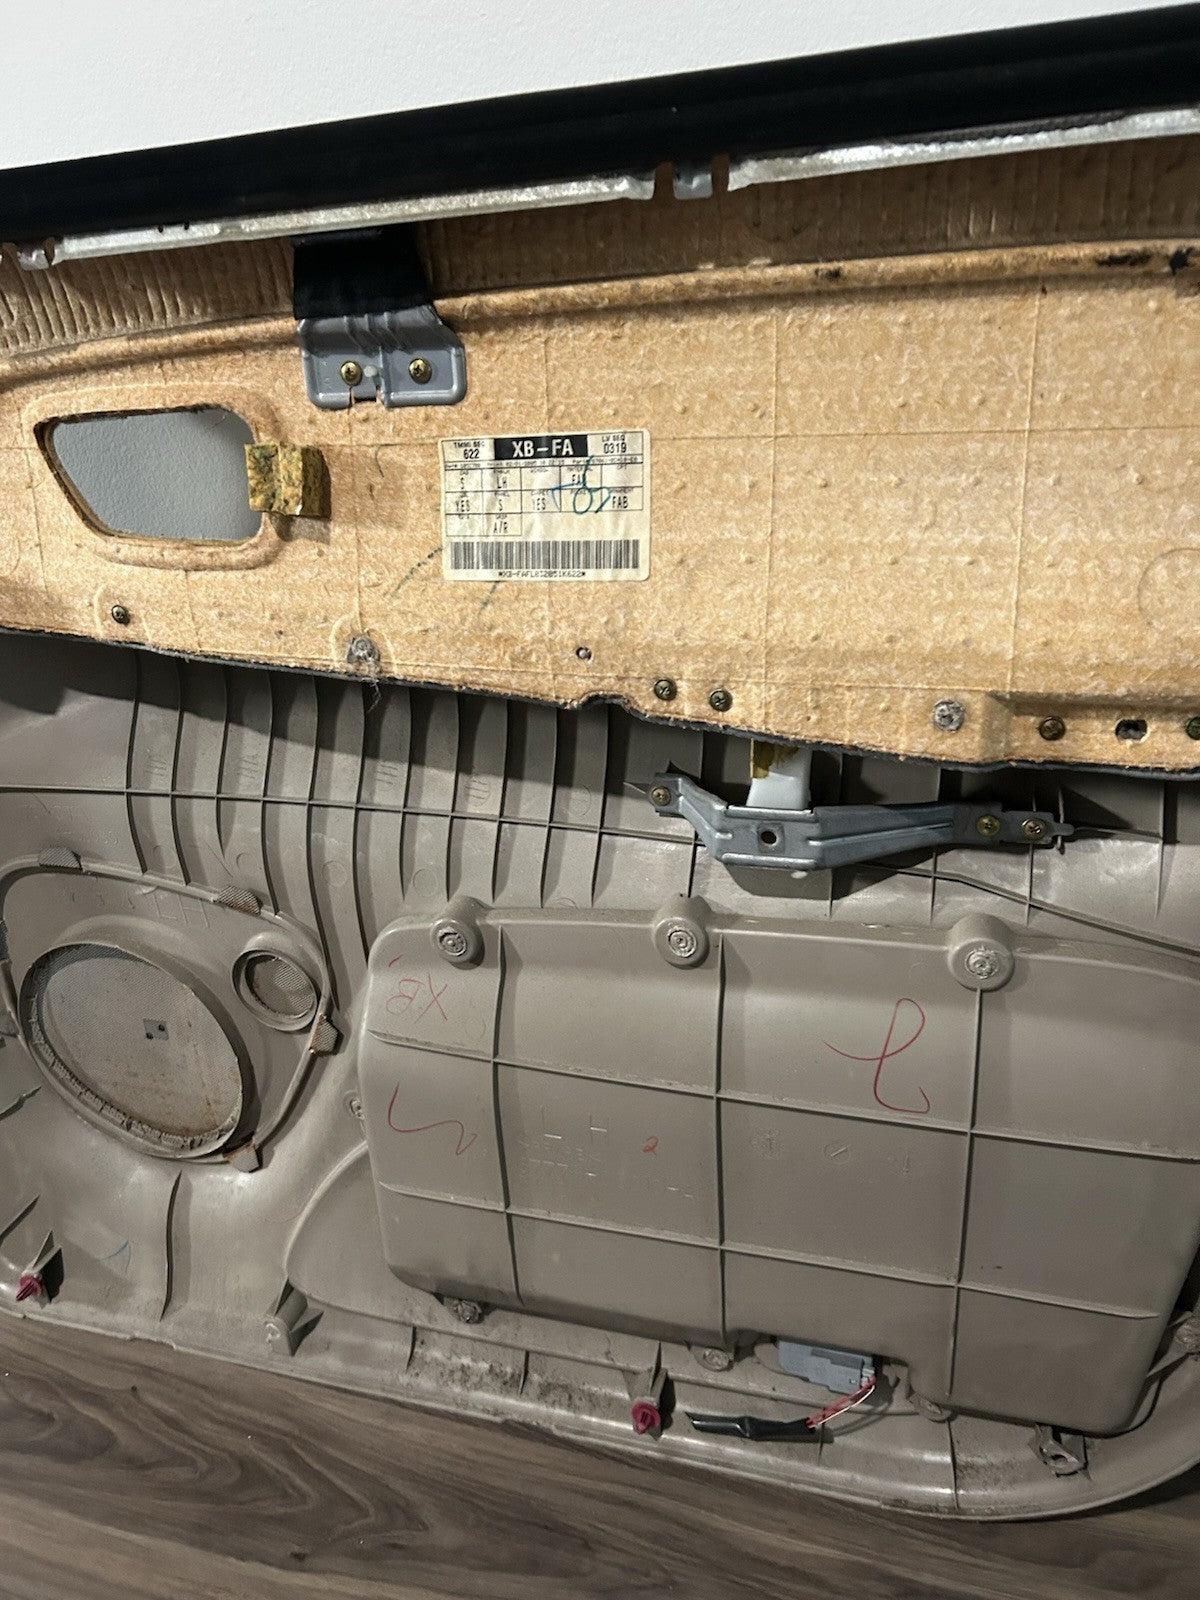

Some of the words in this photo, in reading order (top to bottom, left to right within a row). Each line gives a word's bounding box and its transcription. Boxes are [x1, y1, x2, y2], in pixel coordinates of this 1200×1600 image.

[463, 448, 480, 460] 622
[511, 438, 575, 460] XB-FA
[603, 442, 627, 455] 0319
[454, 499, 470, 512] YES
[612, 496, 628, 509] FAB
